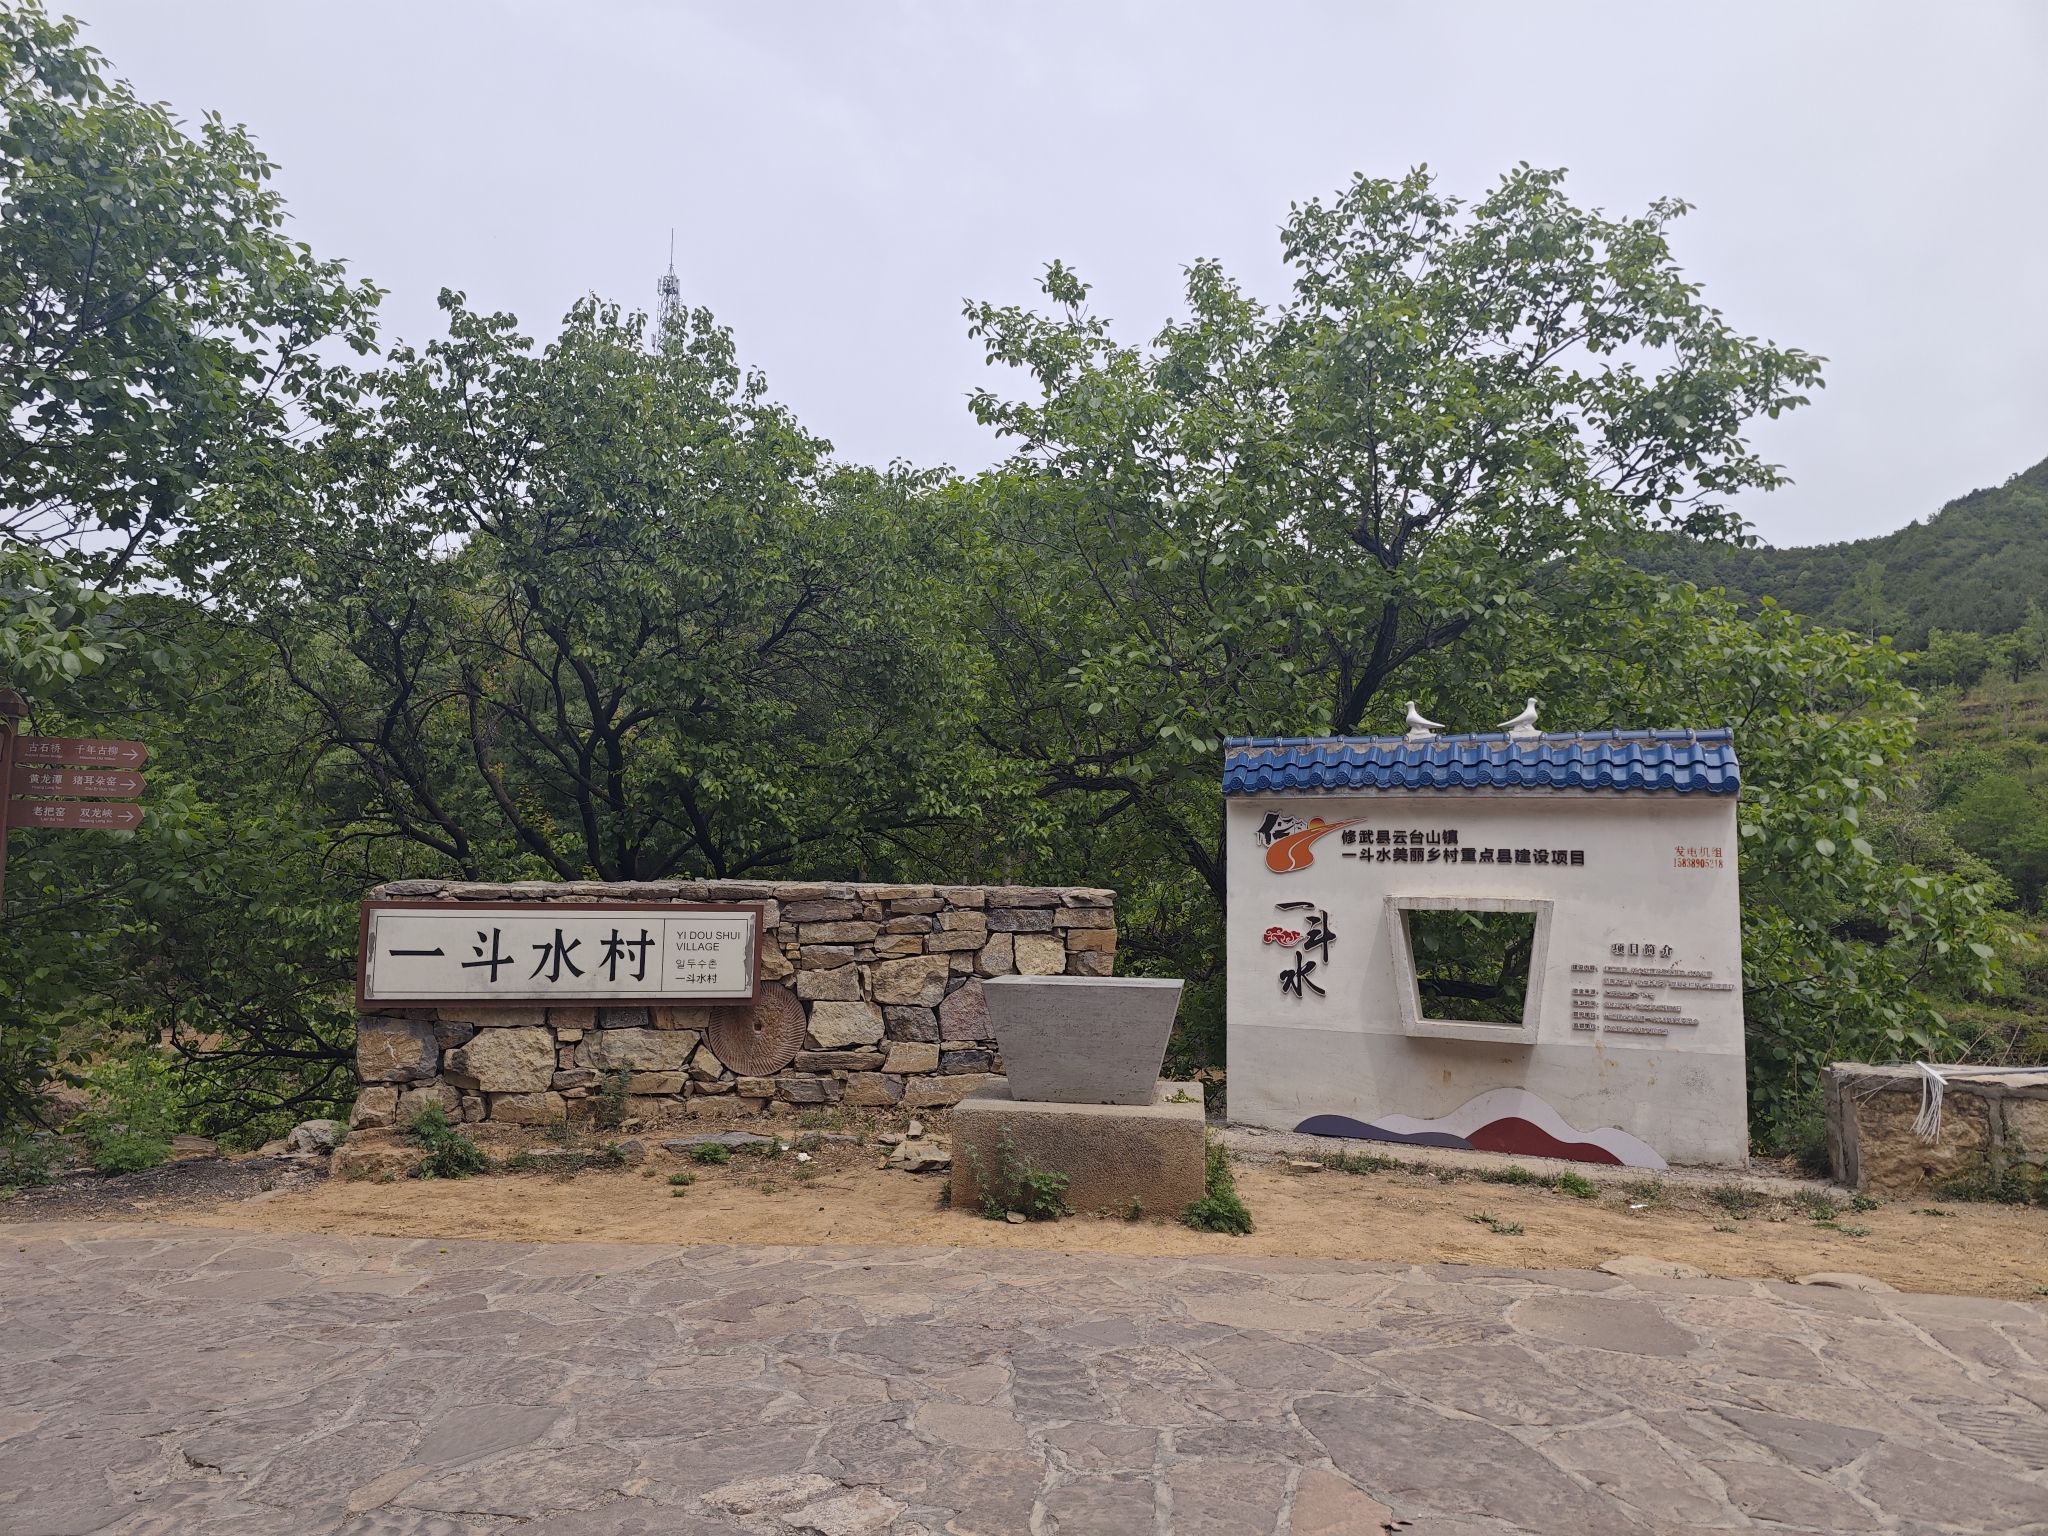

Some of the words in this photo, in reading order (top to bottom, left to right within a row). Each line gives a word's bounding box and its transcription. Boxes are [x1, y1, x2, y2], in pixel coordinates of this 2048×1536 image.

[28, 742, 61, 754] 古石桥
[72, 775, 117, 786] 猪耳朵窑
[1341, 829, 1459, 846] 修武县云台山镇
[1341, 848, 1586, 866] 一斗水美丽乡村重点县建设项目
[1674, 845, 1723, 858] 发电机组
[676, 931, 687, 940] YI
[689, 931, 713, 940] DOU
[715, 931, 741, 940] SHUI
[676, 942, 720, 951] VILLAGE
[1275, 901, 1337, 998] 一斗水
[1611, 943, 1673, 958] 项目简介
[388, 927, 656, 983] 一斗水村
[675, 959, 717, 970] 일두수촌
[675, 973, 718, 984] 一斗水村
